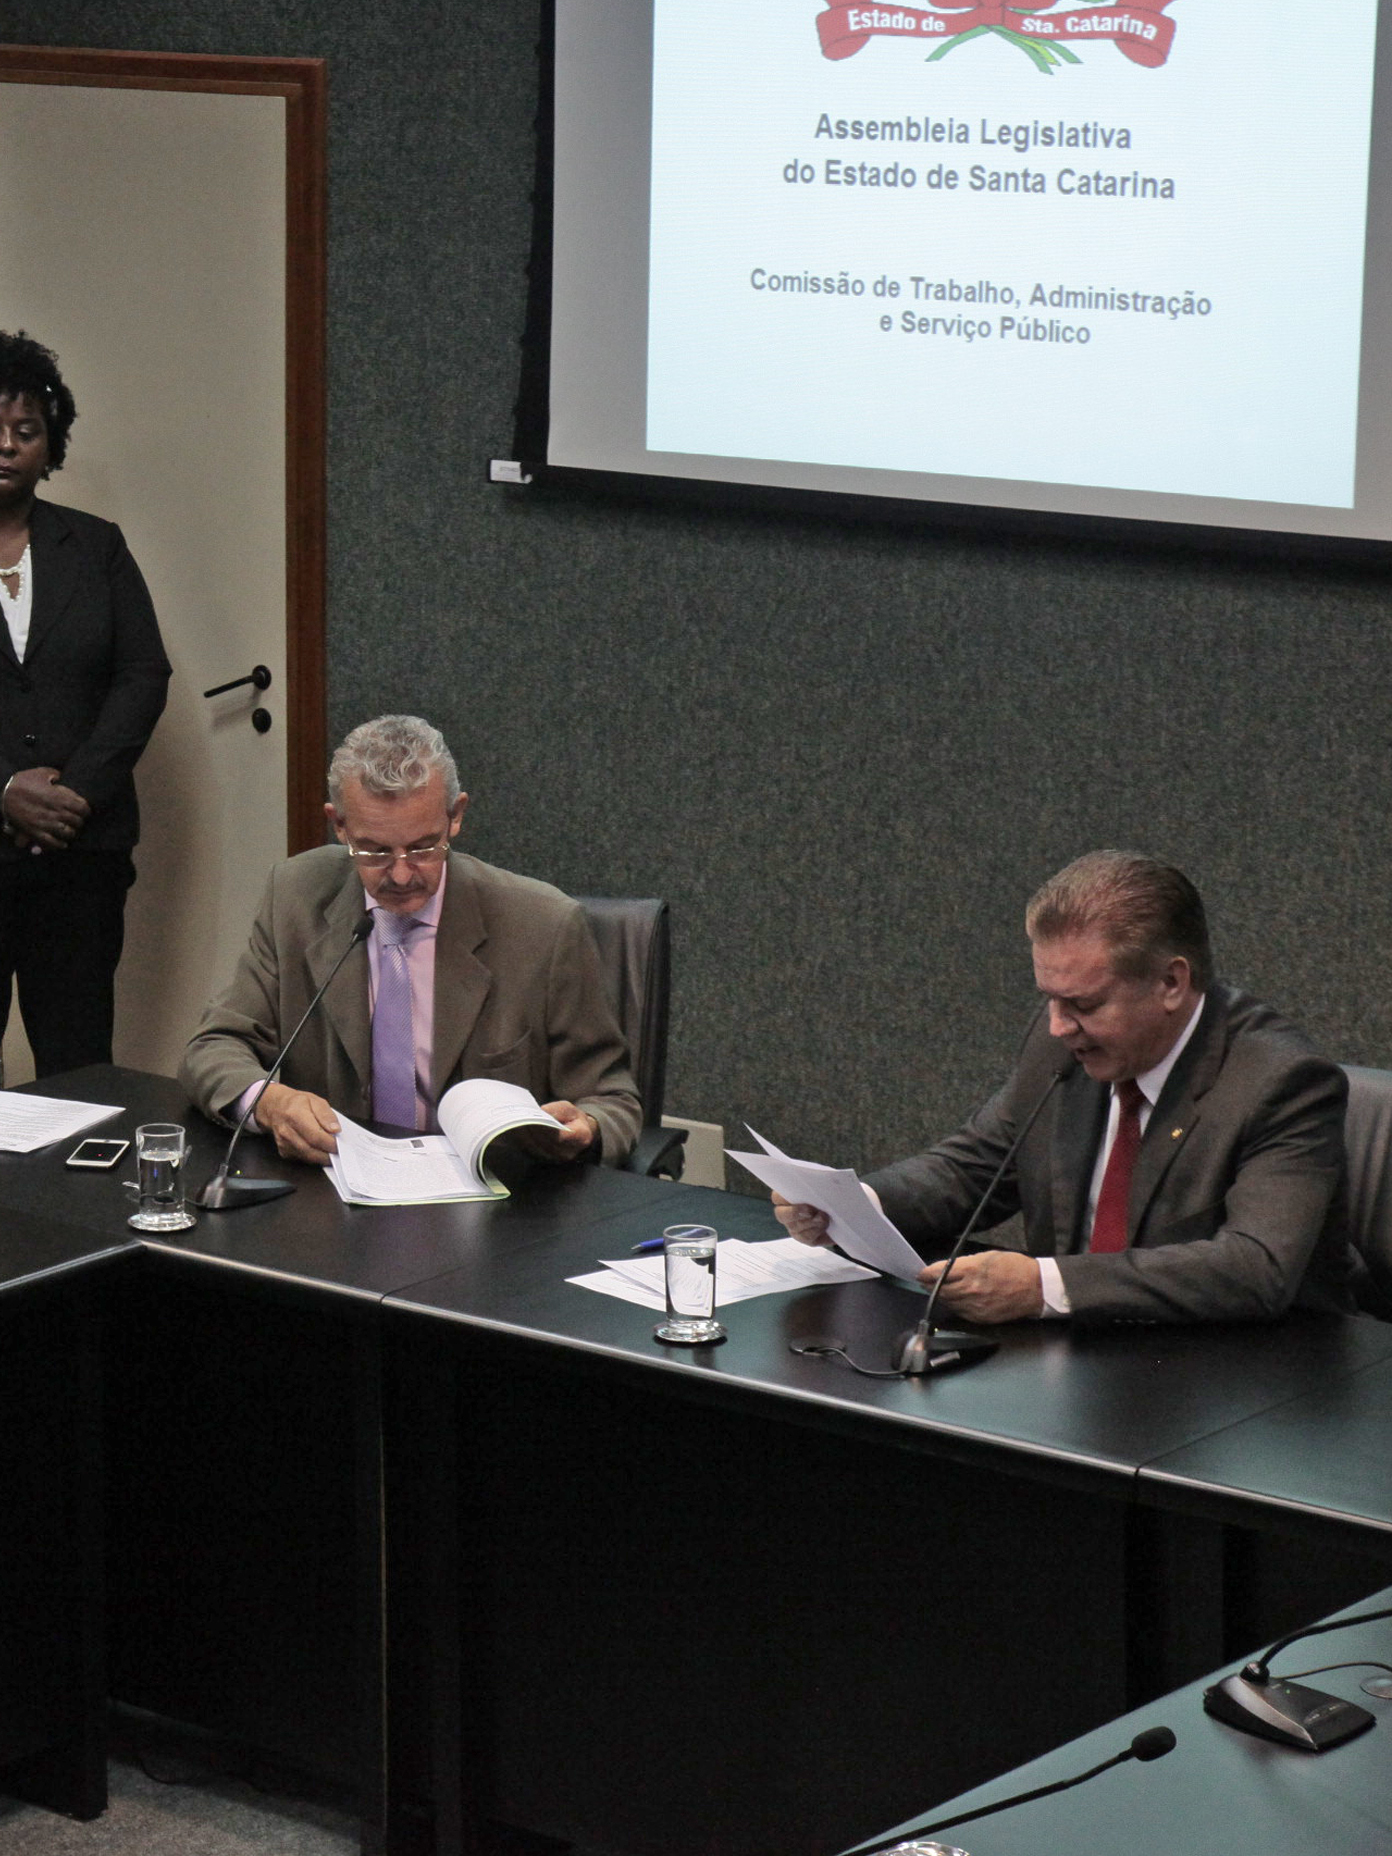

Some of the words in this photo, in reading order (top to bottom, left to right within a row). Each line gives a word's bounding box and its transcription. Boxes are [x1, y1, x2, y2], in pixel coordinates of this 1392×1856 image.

[847, 9, 916, 31] Estado
[921, 16, 946, 32] de
[1021, 17, 1061, 33] Sta.
[1065, 14, 1158, 40] Catarina
[814, 113, 969, 144] Assembleia
[980, 118, 1132, 153] Legislativa
[783, 158, 816, 184] do
[825, 159, 917, 188] Estado
[926, 163, 959, 190] de
[968, 164, 1046, 194] Santa
[1057, 167, 1175, 199] Catarina
[750, 268, 866, 296] Comissão
[873, 275, 901, 298] de
[910, 276, 1021, 309] Trabalho,
[1029, 283, 1212, 320] Administração
[879, 314, 893, 332] e
[901, 310, 992, 343] Serviço
[1000, 316, 1091, 344] Público
